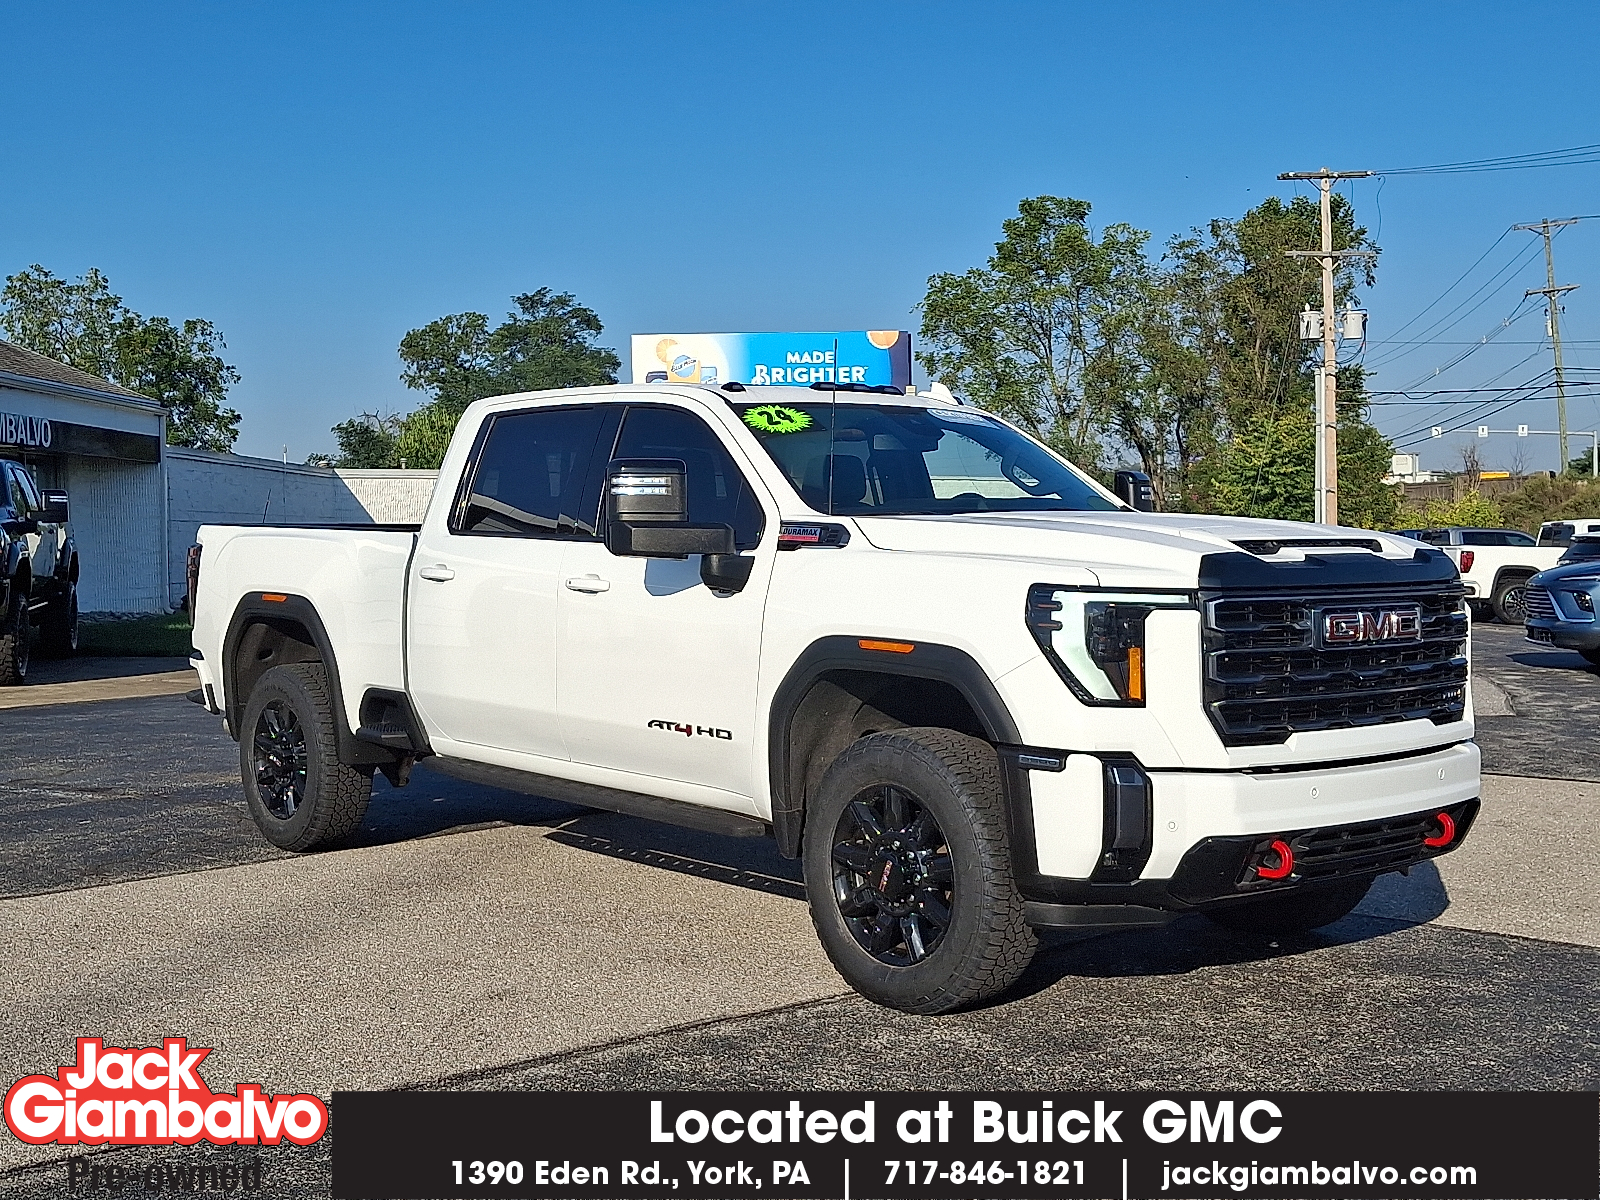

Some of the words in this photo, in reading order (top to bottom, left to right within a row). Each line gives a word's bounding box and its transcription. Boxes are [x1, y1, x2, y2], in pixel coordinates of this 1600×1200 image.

[786, 351, 835, 364] MADE
[751, 364, 866, 385] BRIGHTER
[783, 528, 818, 536] DURAMAX
[1326, 608, 1421, 642] GMC
[647, 719, 692, 737] AT4
[696, 725, 733, 741] HD
